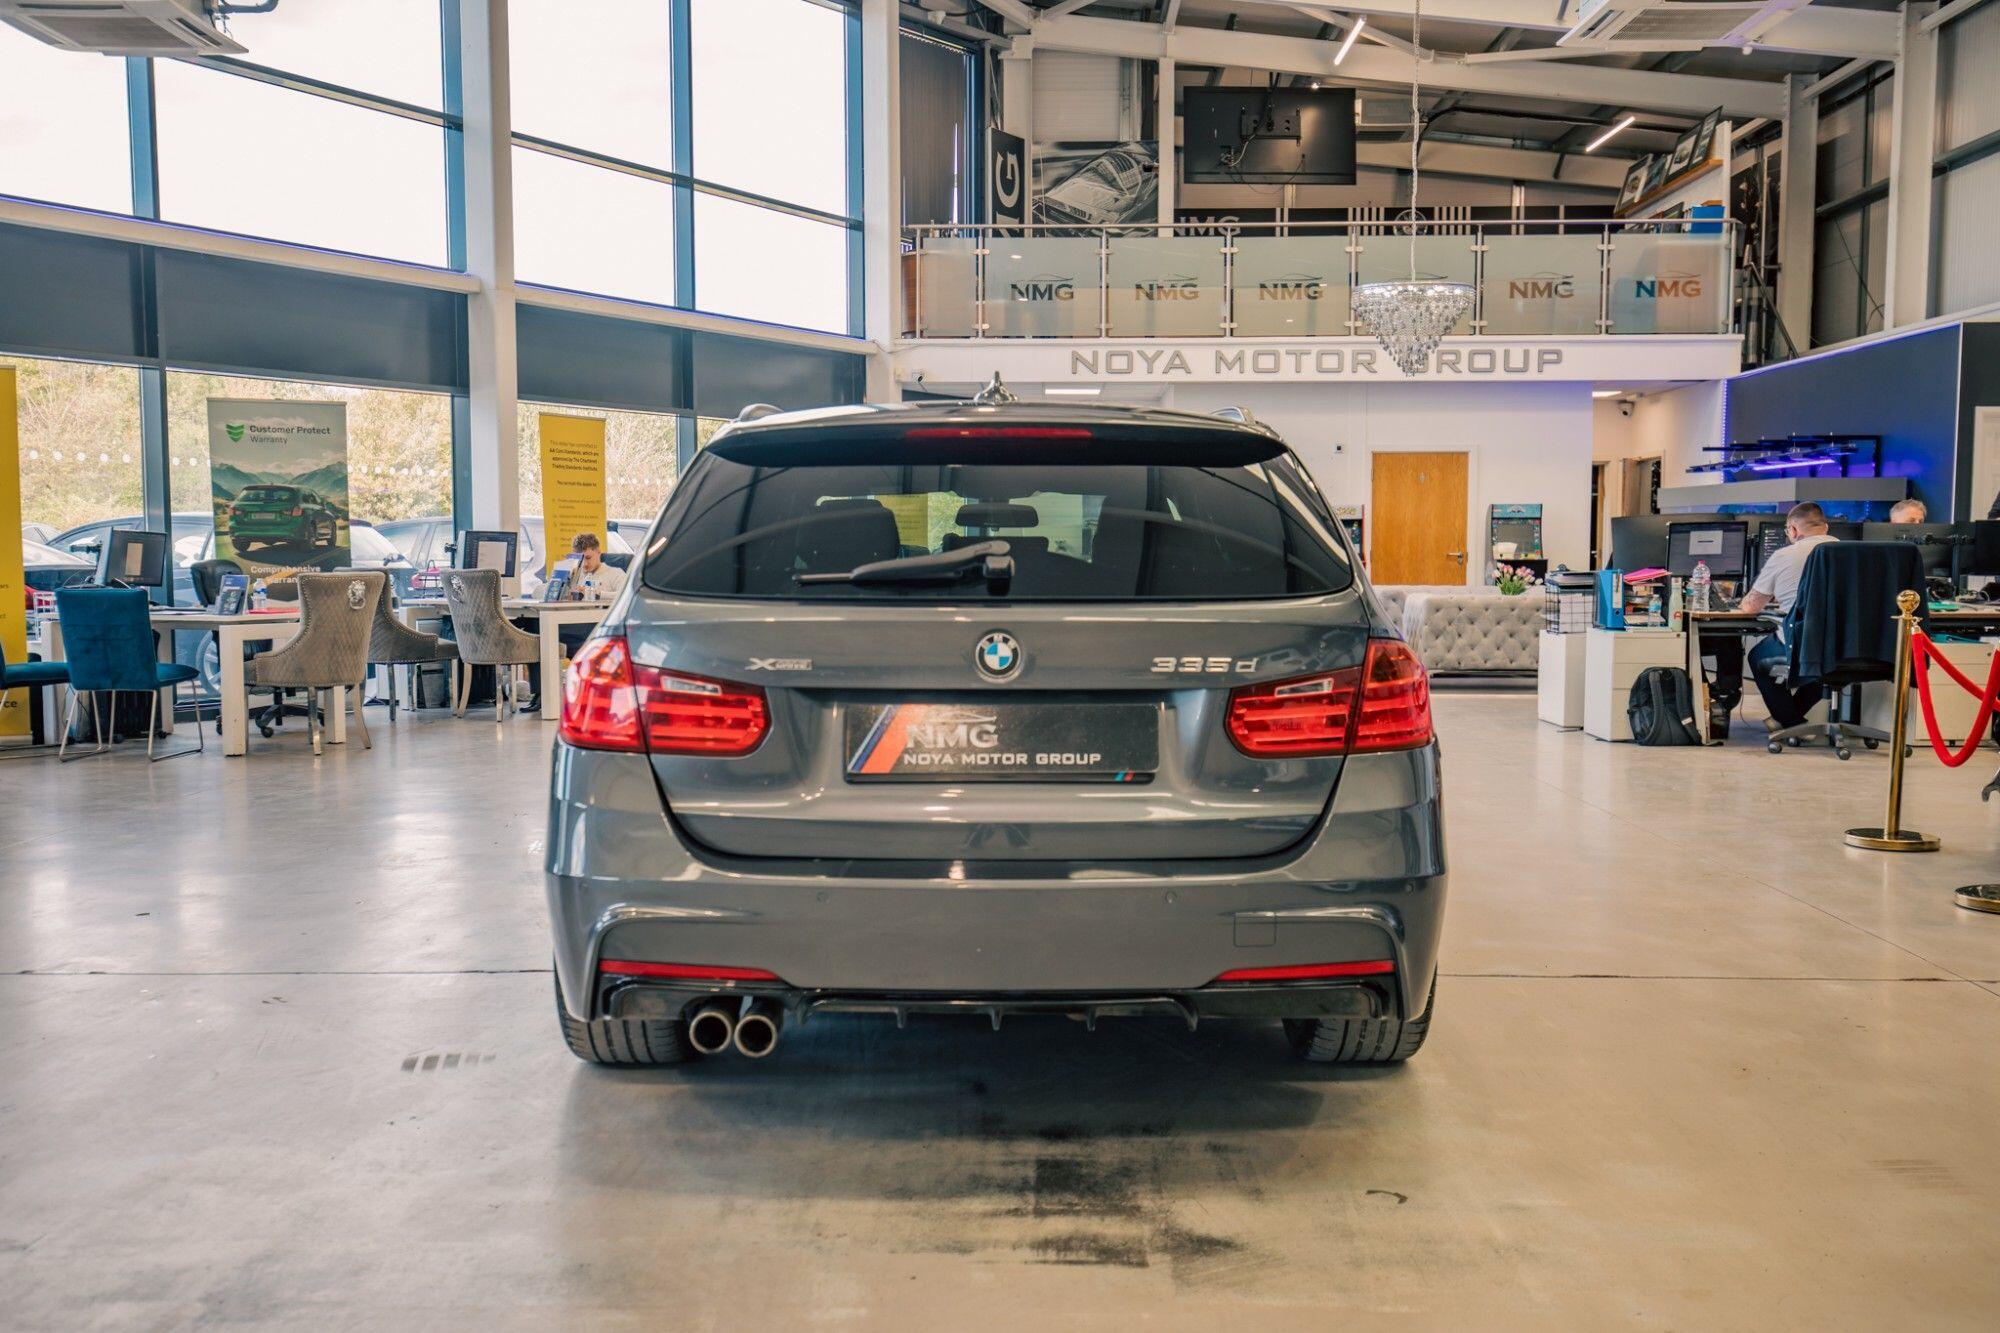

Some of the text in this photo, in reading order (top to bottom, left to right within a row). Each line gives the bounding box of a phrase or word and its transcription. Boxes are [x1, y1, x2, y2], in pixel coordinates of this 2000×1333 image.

[1010, 283, 1074, 301] NMG
[1135, 283, 1199, 301] NMG
[1259, 282, 1324, 300] NMG
[1508, 280, 1575, 299] NMG
[1635, 279, 1702, 298] NMG
[1071, 349, 1191, 374] NOYA
[1215, 349, 1377, 374] MOTOR
[249, 425, 331, 435] Customer Protect
[250, 436, 288, 444] Warranty
[250, 565, 321, 573] Comprehensive
[905, 723, 998, 749] NMG
[903, 752, 1102, 766] NOYA MOTOR GROUP
